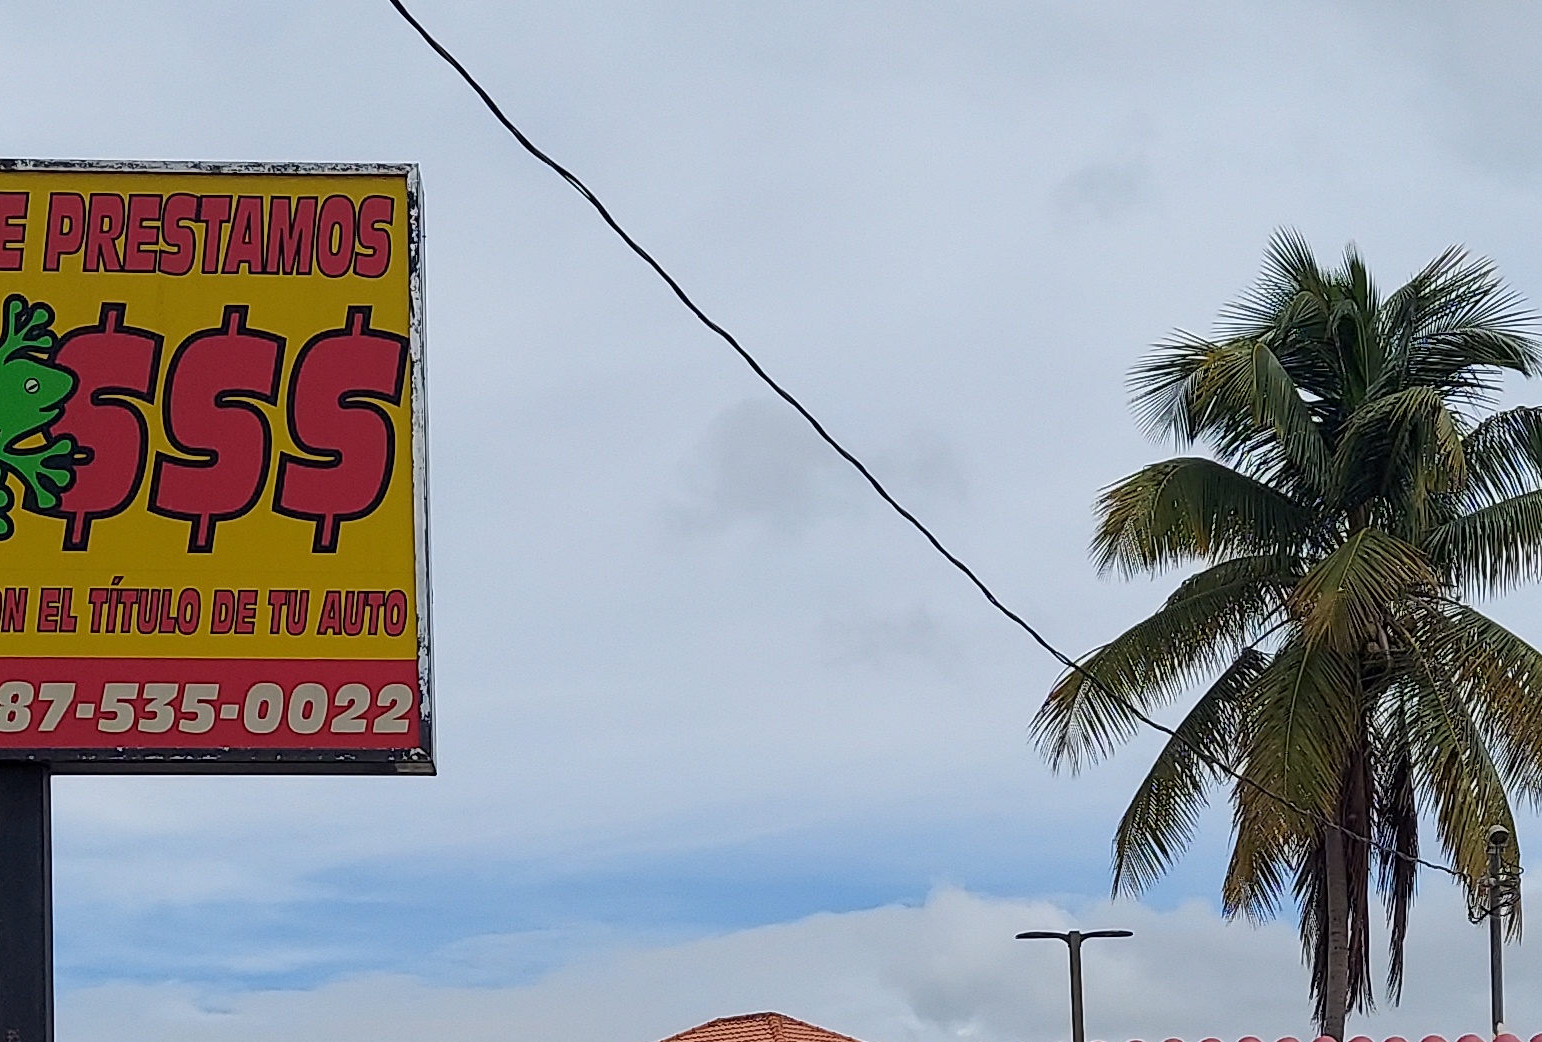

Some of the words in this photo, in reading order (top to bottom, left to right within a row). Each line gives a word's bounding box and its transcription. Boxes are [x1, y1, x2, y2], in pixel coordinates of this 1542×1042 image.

[42, 192, 395, 279] PRESTAMOS
[37, 587, 77, 634] EL
[89, 576, 202, 635] TÍTULO
[211, 589, 258, 635] DE
[268, 590, 309, 636] TU
[317, 590, 408, 637] AUTO
